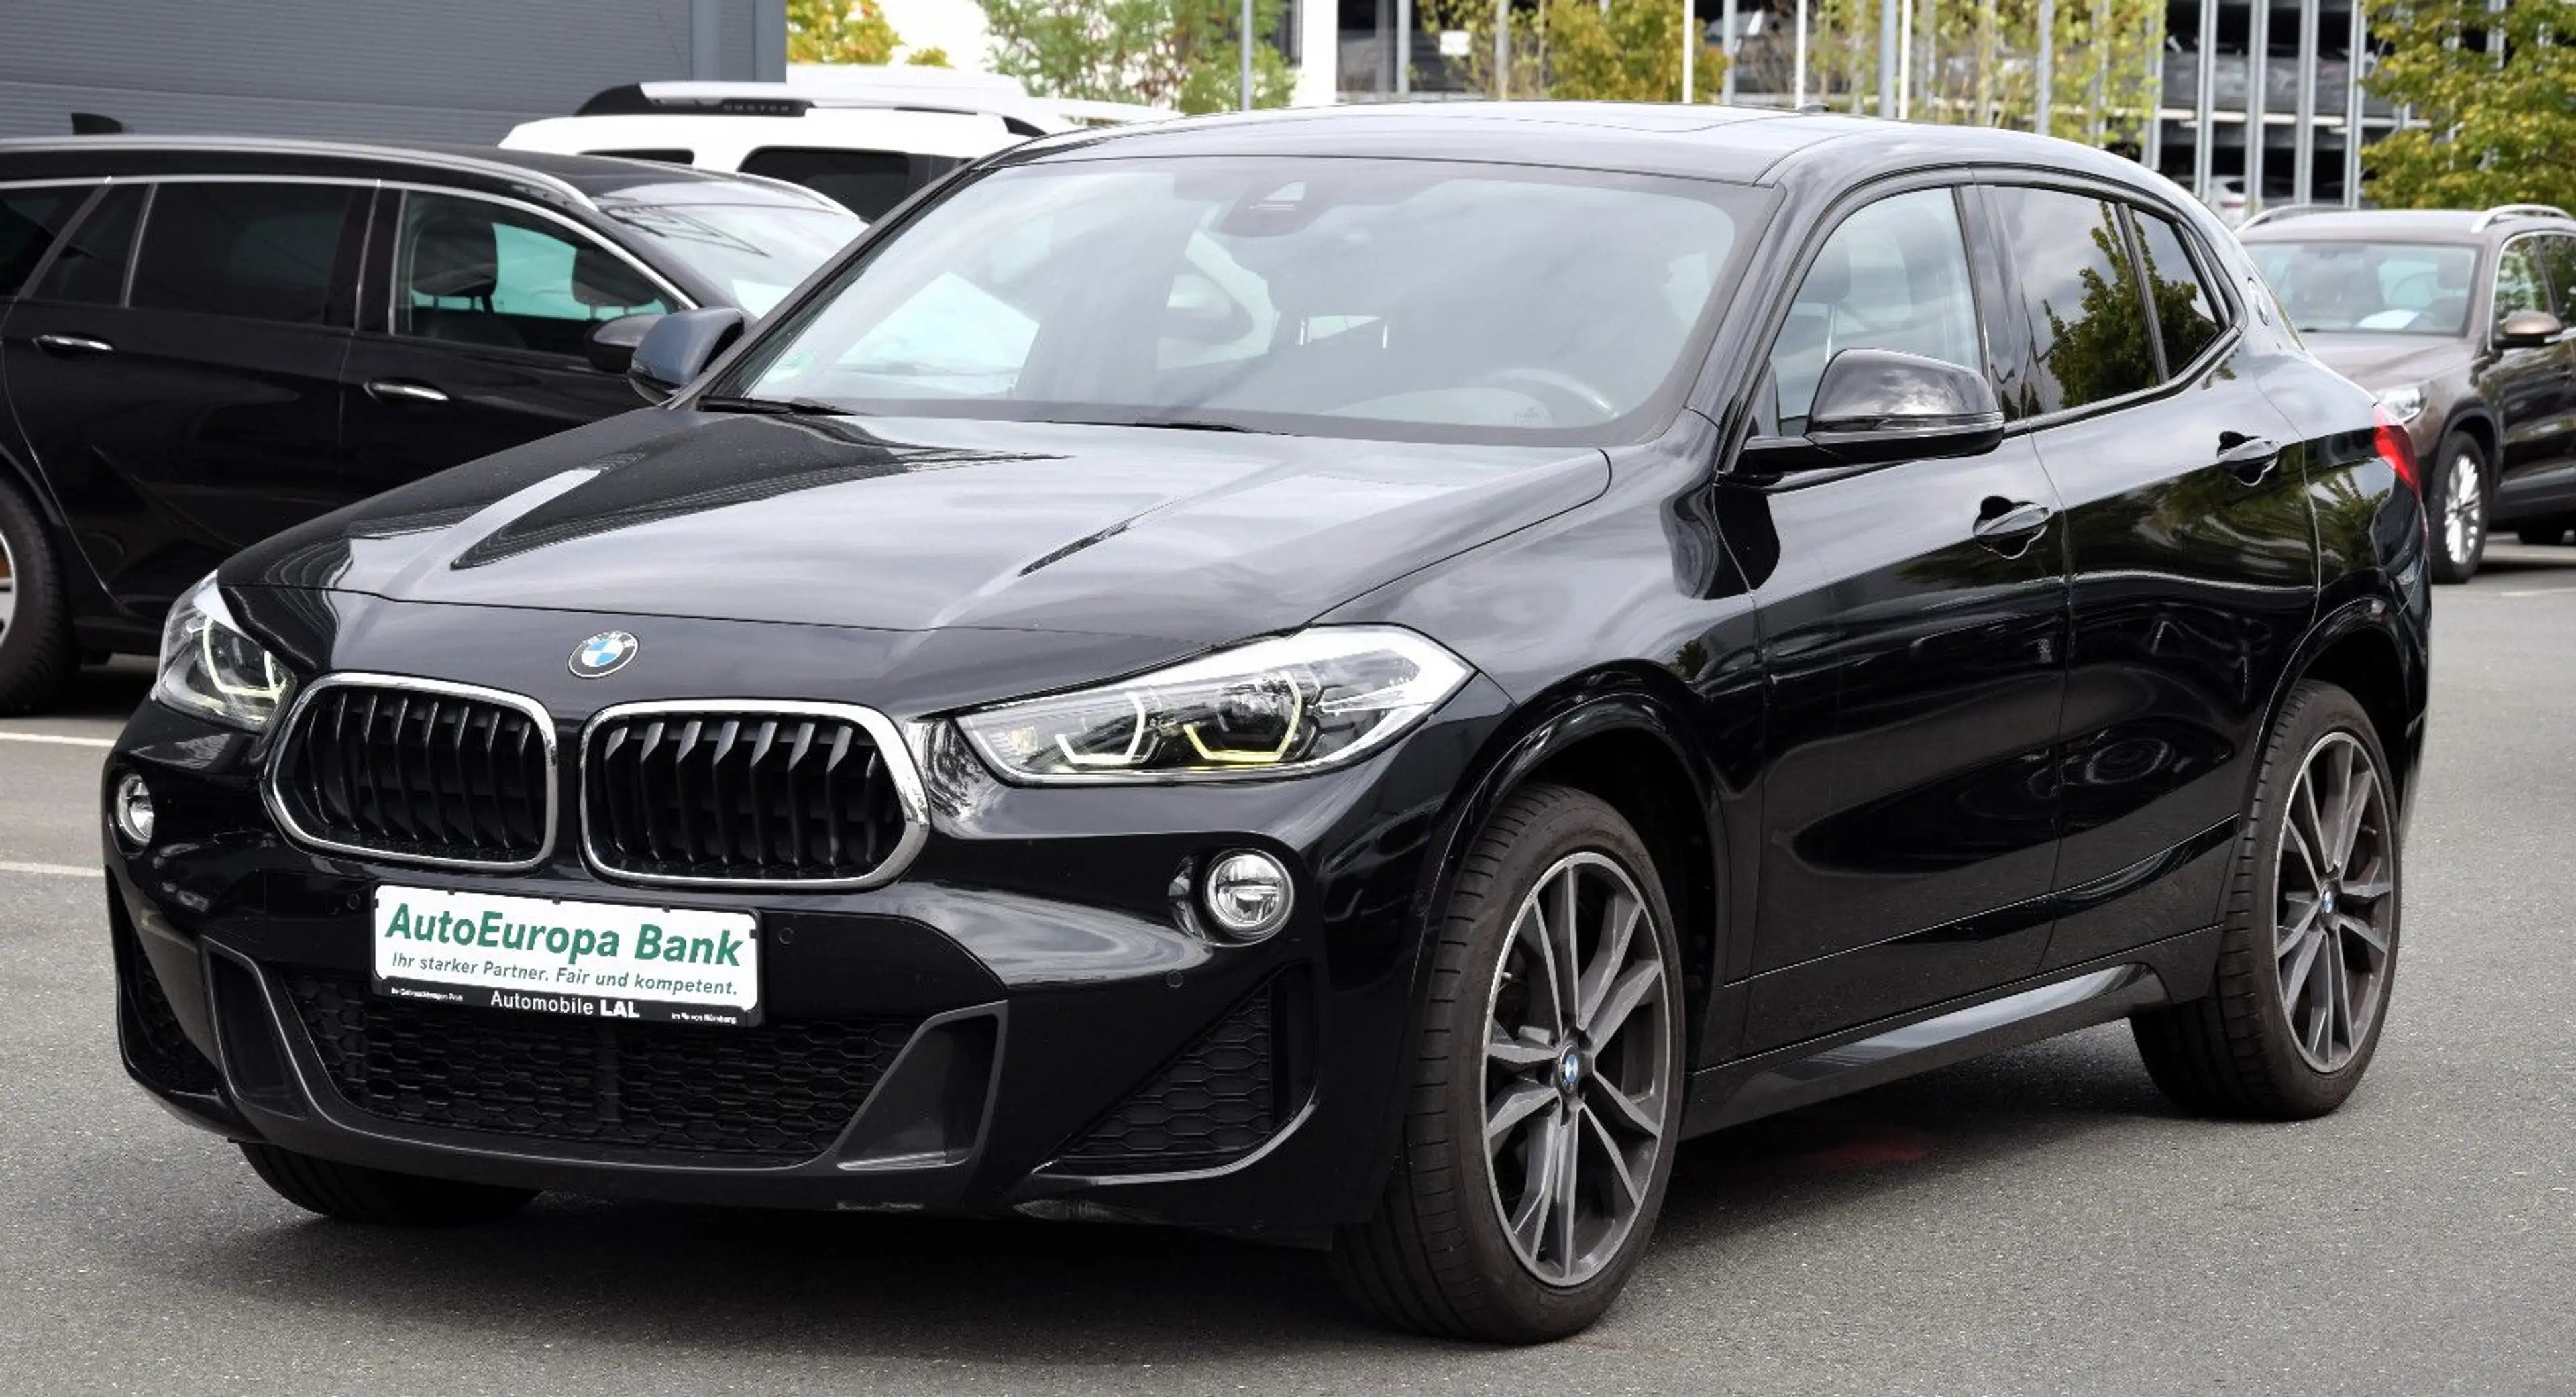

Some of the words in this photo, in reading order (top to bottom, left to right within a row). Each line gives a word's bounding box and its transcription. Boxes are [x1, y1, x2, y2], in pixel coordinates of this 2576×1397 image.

[384, 903, 619, 964] AutoEuropa
[635, 924, 743, 966] Bank
[392, 952, 415, 968] Ihr
[419, 956, 478, 974] starker
[483, 960, 549, 981] Partner.
[555, 967, 590, 985] Fair
[596, 972, 629, 987] und
[635, 974, 737, 995] kompetent.
[491, 990, 594, 1015] Automobile
[600, 999, 640, 1018] LAL
